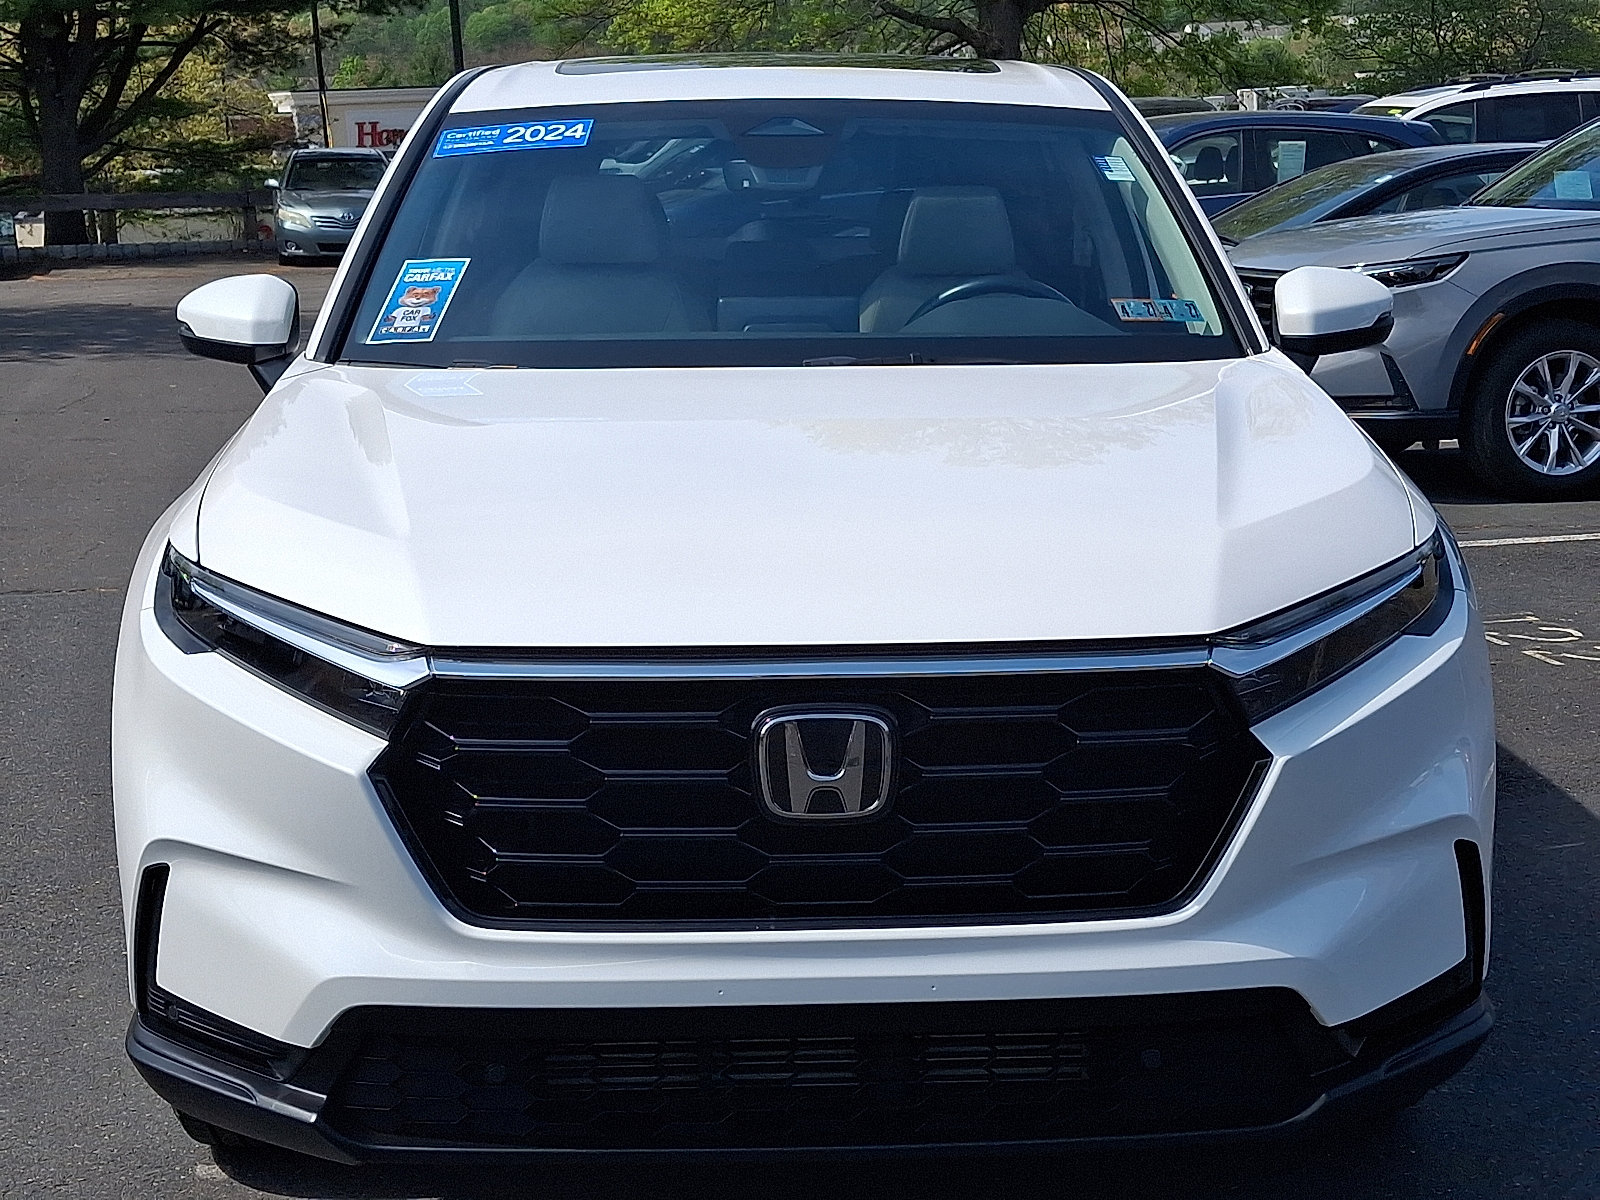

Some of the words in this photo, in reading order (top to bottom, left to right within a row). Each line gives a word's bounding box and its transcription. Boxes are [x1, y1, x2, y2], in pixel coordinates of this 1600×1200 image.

[446, 128, 501, 139] Certified
[502, 122, 587, 144] 2024
[404, 272, 453, 282] CARFAX
